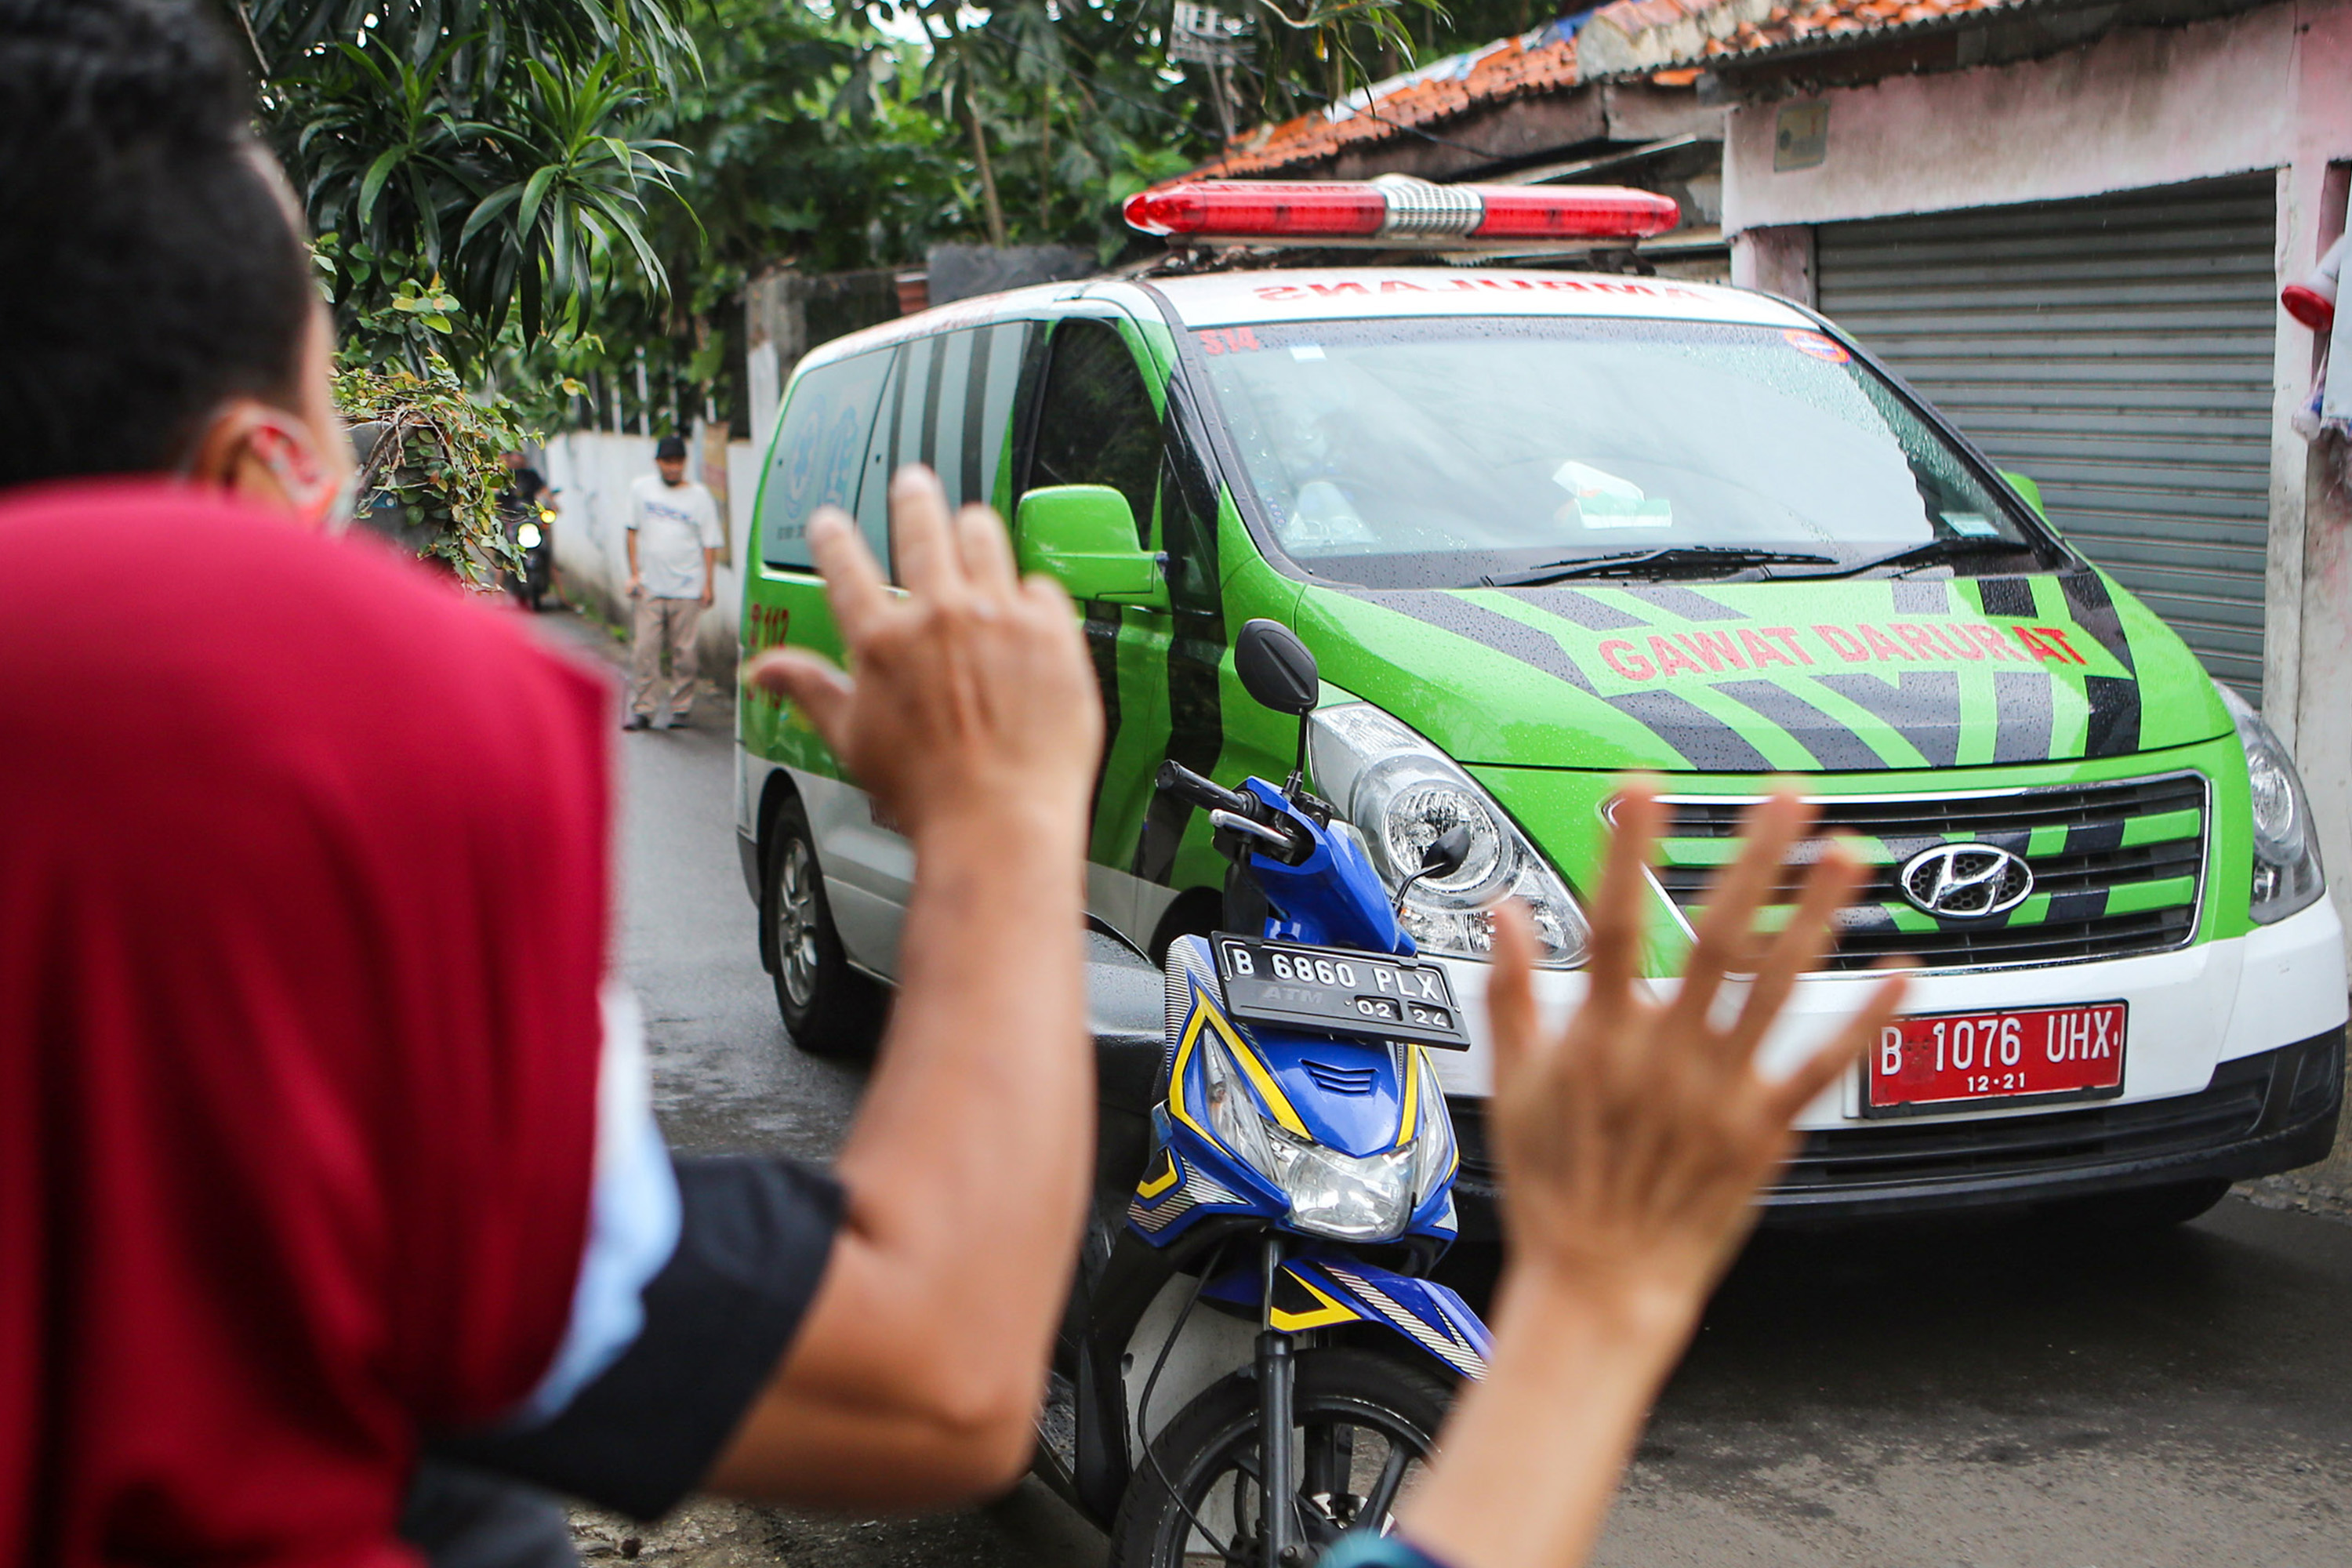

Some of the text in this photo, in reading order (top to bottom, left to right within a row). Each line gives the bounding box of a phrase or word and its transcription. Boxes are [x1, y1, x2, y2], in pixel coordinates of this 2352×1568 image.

[1599, 623, 2088, 681] GAWAT DARURAT
[1233, 949, 1439, 1000] B 6860 PLX
[1263, 986, 1323, 1004] ATM
[1356, 1000, 1392, 1018] 02
[1881, 1010, 2113, 1076] B 1076 UHX
